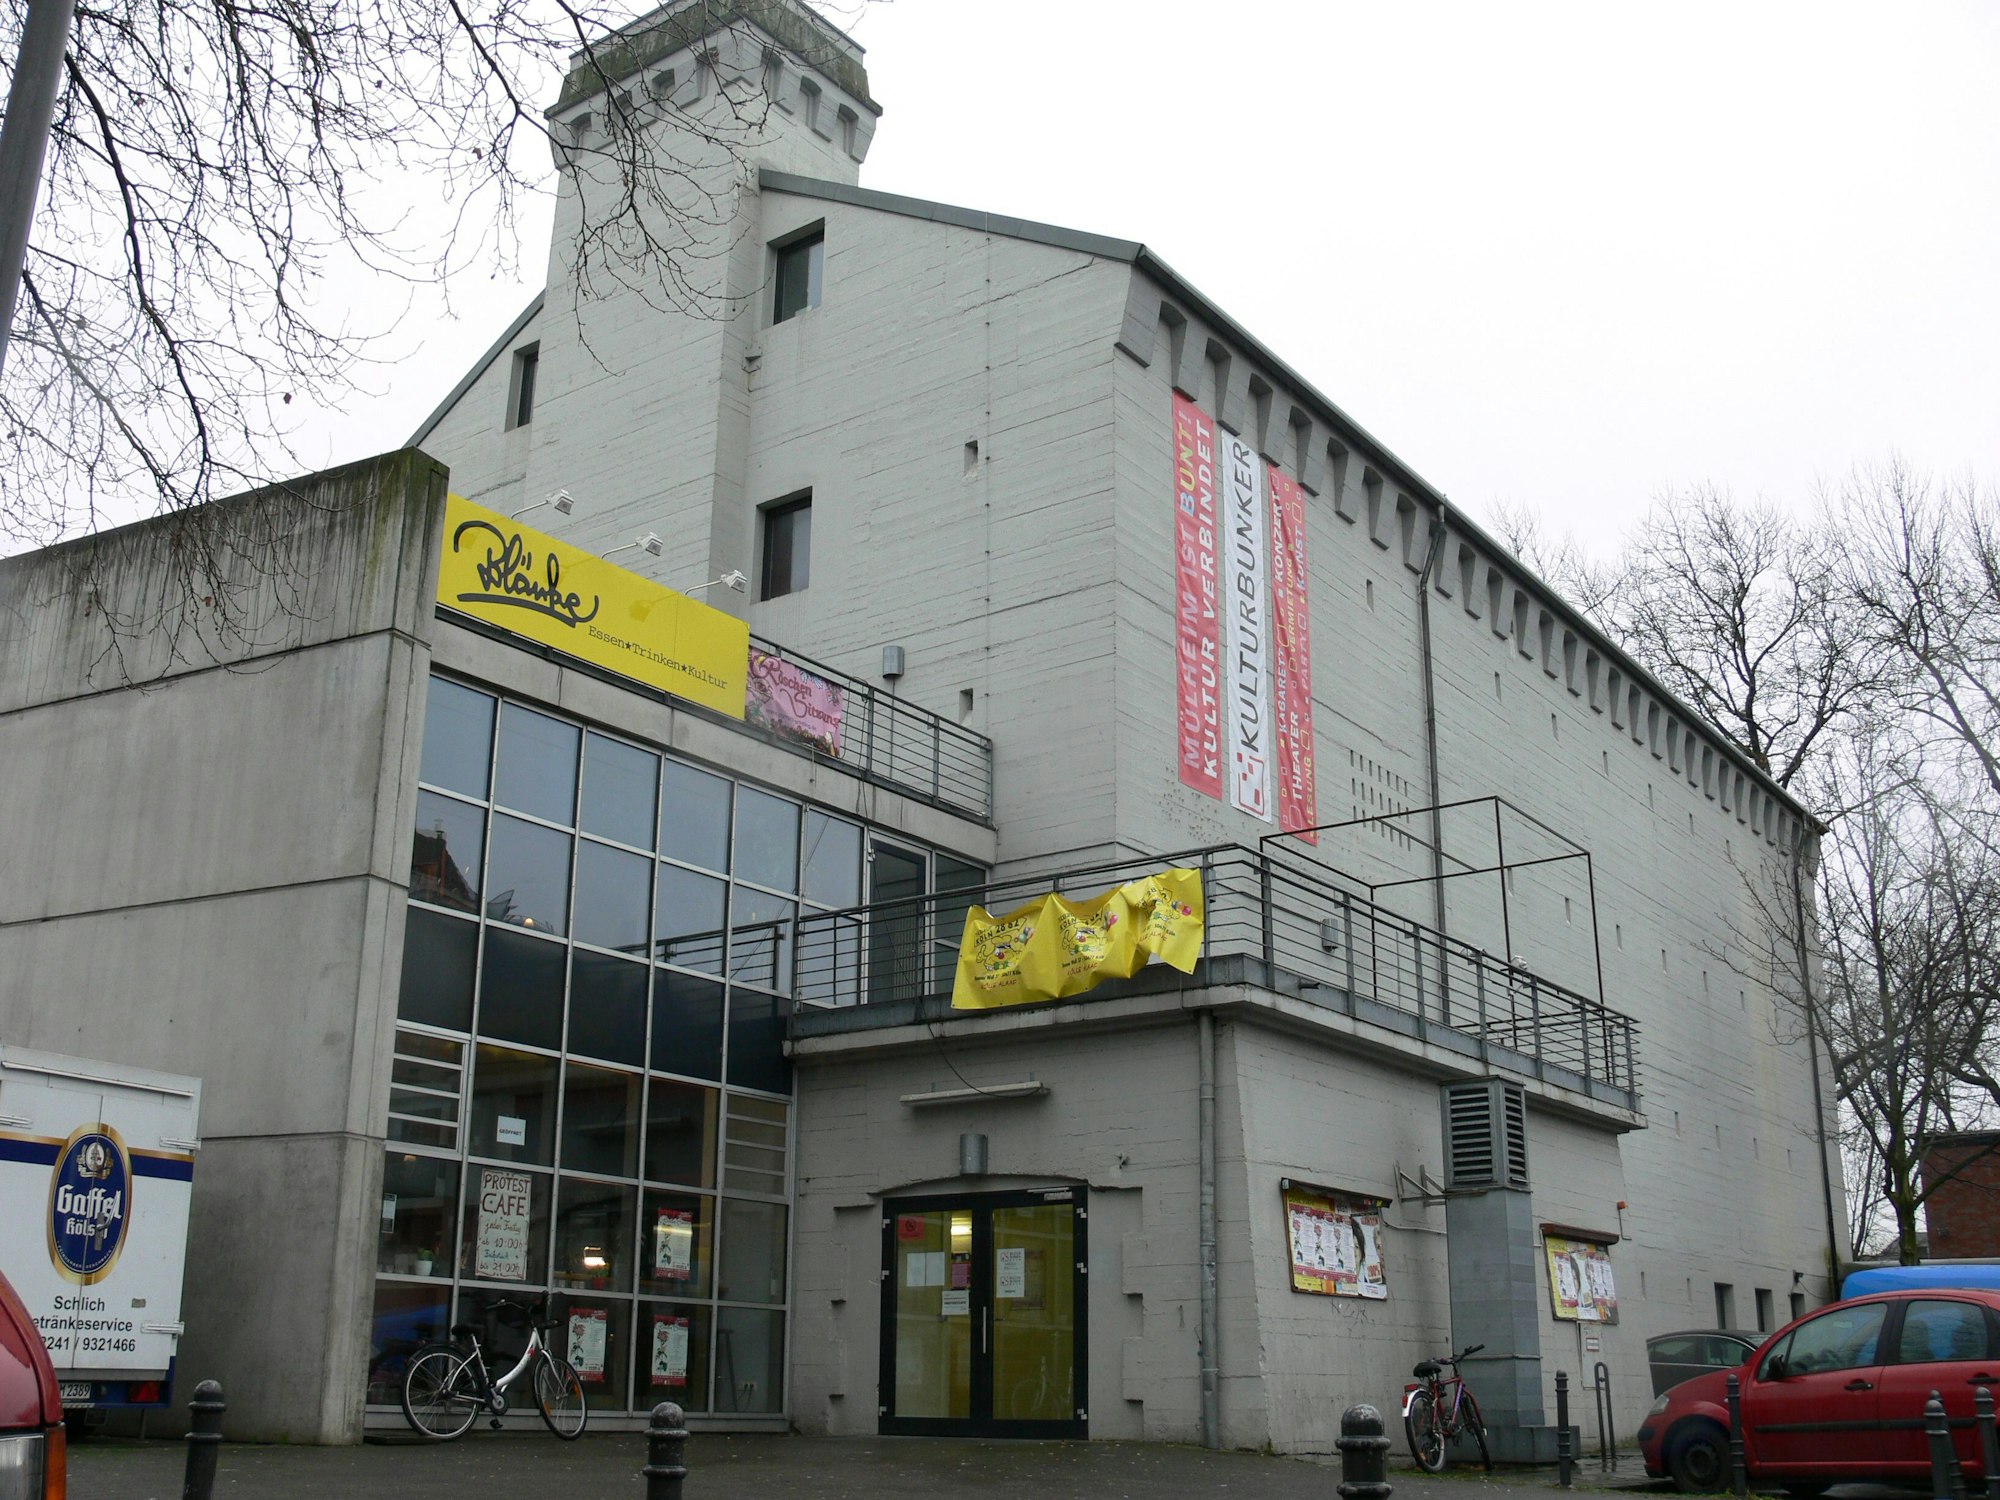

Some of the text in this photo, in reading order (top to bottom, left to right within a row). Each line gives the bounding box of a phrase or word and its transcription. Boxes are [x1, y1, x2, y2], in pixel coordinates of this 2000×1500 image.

[1181, 523, 1197, 578] IST
[1196, 418, 1217, 779] KULTUR VERBINDET
[1232, 441, 1260, 753] KULTURBUNKER
[1271, 490, 1288, 734] KABARETT KONZERT
[588, 625, 728, 690] Essen Trinken Kultur
[1180, 591, 1200, 769] MÜLHEIM
[1286, 557, 1303, 801] THEATER VERMIETUNG
[1296, 525, 1314, 826] LESUNG PARTY KUNST
[57, 1184, 122, 1220] Gaffel
[482, 1192, 526, 1217] CAFE
[483, 1173, 531, 1194] PROTEST
[33, 1315, 133, 1332] etränkeservice
[54, 1295, 105, 1311] Schlich
[83, 1337, 136, 1352] 9321466
[66, 1383, 90, 1397] 2389
